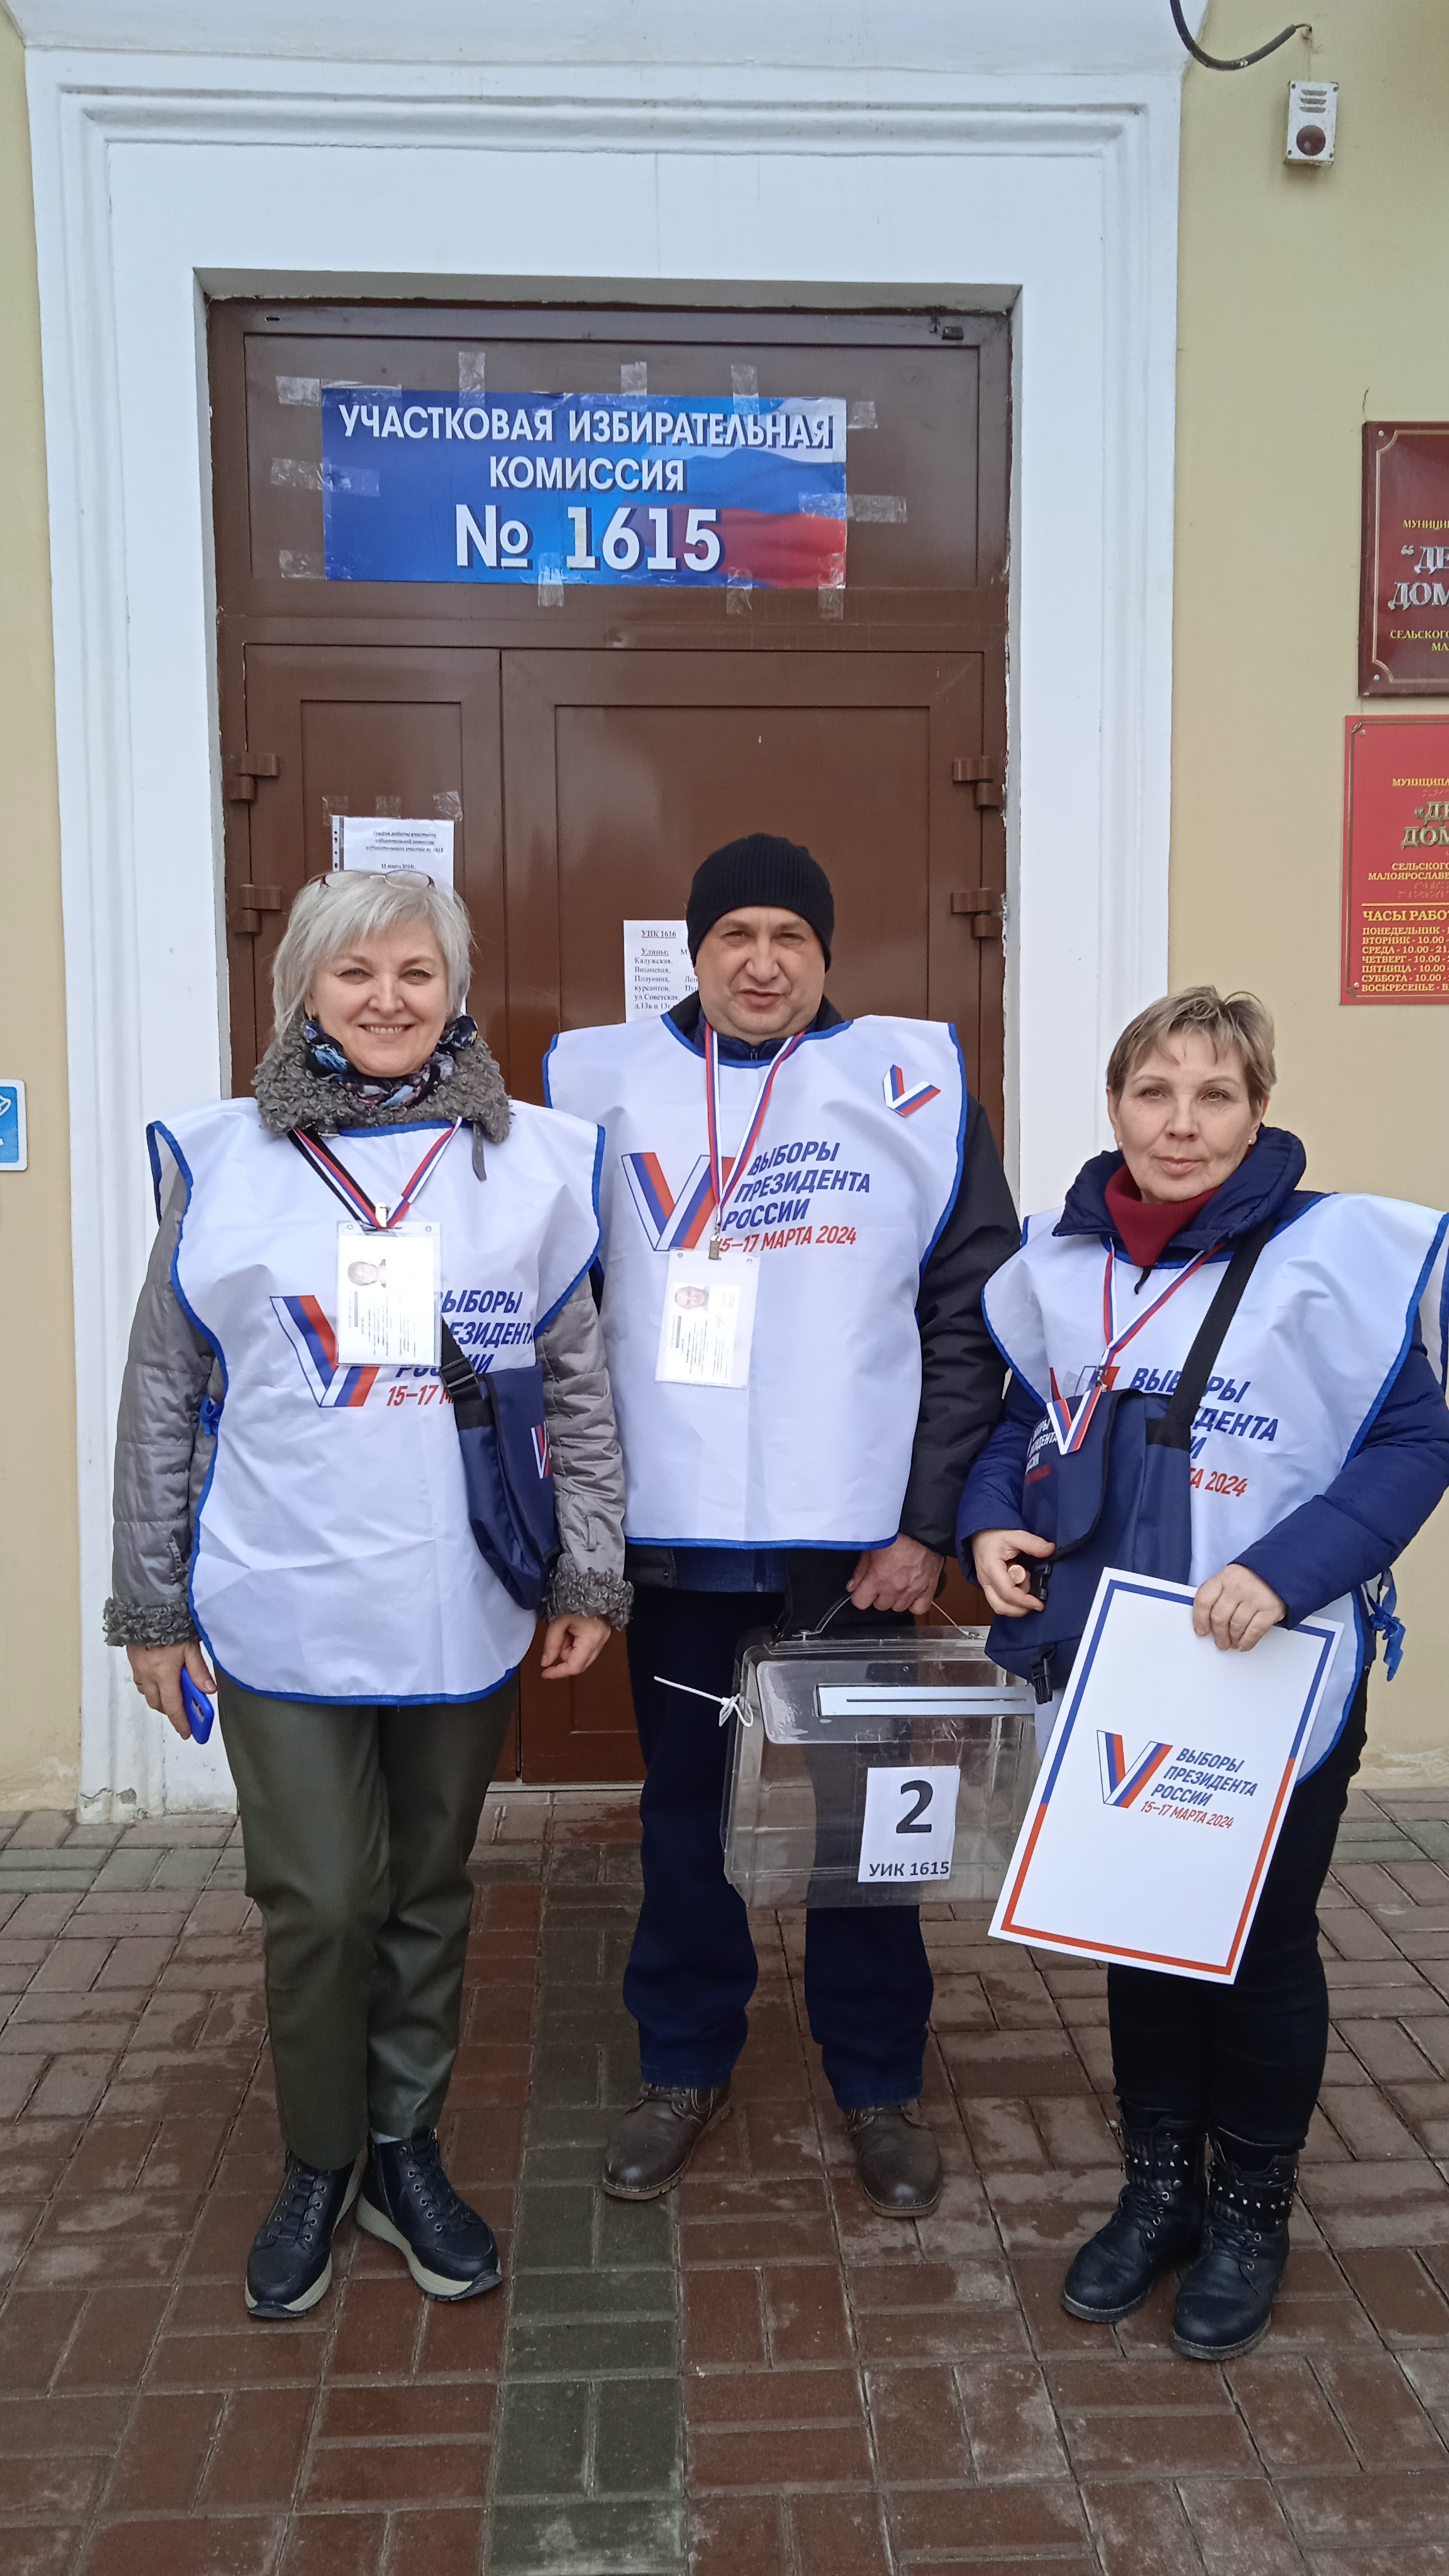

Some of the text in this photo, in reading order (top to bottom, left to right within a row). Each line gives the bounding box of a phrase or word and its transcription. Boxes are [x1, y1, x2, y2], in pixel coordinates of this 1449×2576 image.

[338, 404, 835, 450] УЧАСТКОВАЯ ИЗБИРАТЕЛЬНАЯ
[489, 455, 684, 491] КОМИССИЯ
[456, 504, 722, 572] № 1615
[1432, 643, 1449, 652] МА
[1363, 910, 1449, 921] ЧАСЫ РАБО
[1362, 927, 1440, 936] ПОНЕДЕЛЬНИК
[1362, 947, 1395, 955] СРЕДА
[1362, 965, 1412, 974] ПЯТНИЦА
[1362, 974, 1407, 982] СУББОТА
[1362, 984, 1435, 992] ВОСКРЕСЕНЬЕ
[747, 1141, 840, 1175] ВЫБОРЫ
[733, 1169, 870, 1203] ПРЕЗИДЕНТА
[721, 1198, 811, 1231] РОССИИ
[760, 1226, 813, 1252] МАРТА
[815, 1225, 857, 1245] 2024
[435, 1290, 523, 1314] ЫБОРЫ
[449, 1322, 533, 1348] ЕЗИДЕНТА
[387, 1385, 439, 1406] 15–17
[1130, 1367, 1251, 1403] ВЫБРЫ
[1192, 1407, 1279, 1441] ДЕНТА
[1204, 1471, 1248, 1497] 2024
[1176, 1748, 1245, 1773] ВЫБОРЫ
[1163, 1765, 1258, 1796] ПРЕЗИДЕНТА
[896, 1780, 933, 1834] 2
[1150, 1784, 1213, 1806] РОССИИ
[1140, 1801, 1234, 1829] 15–17 МАРТА 2024
[869, 1862, 949, 1877] УИК 1615
